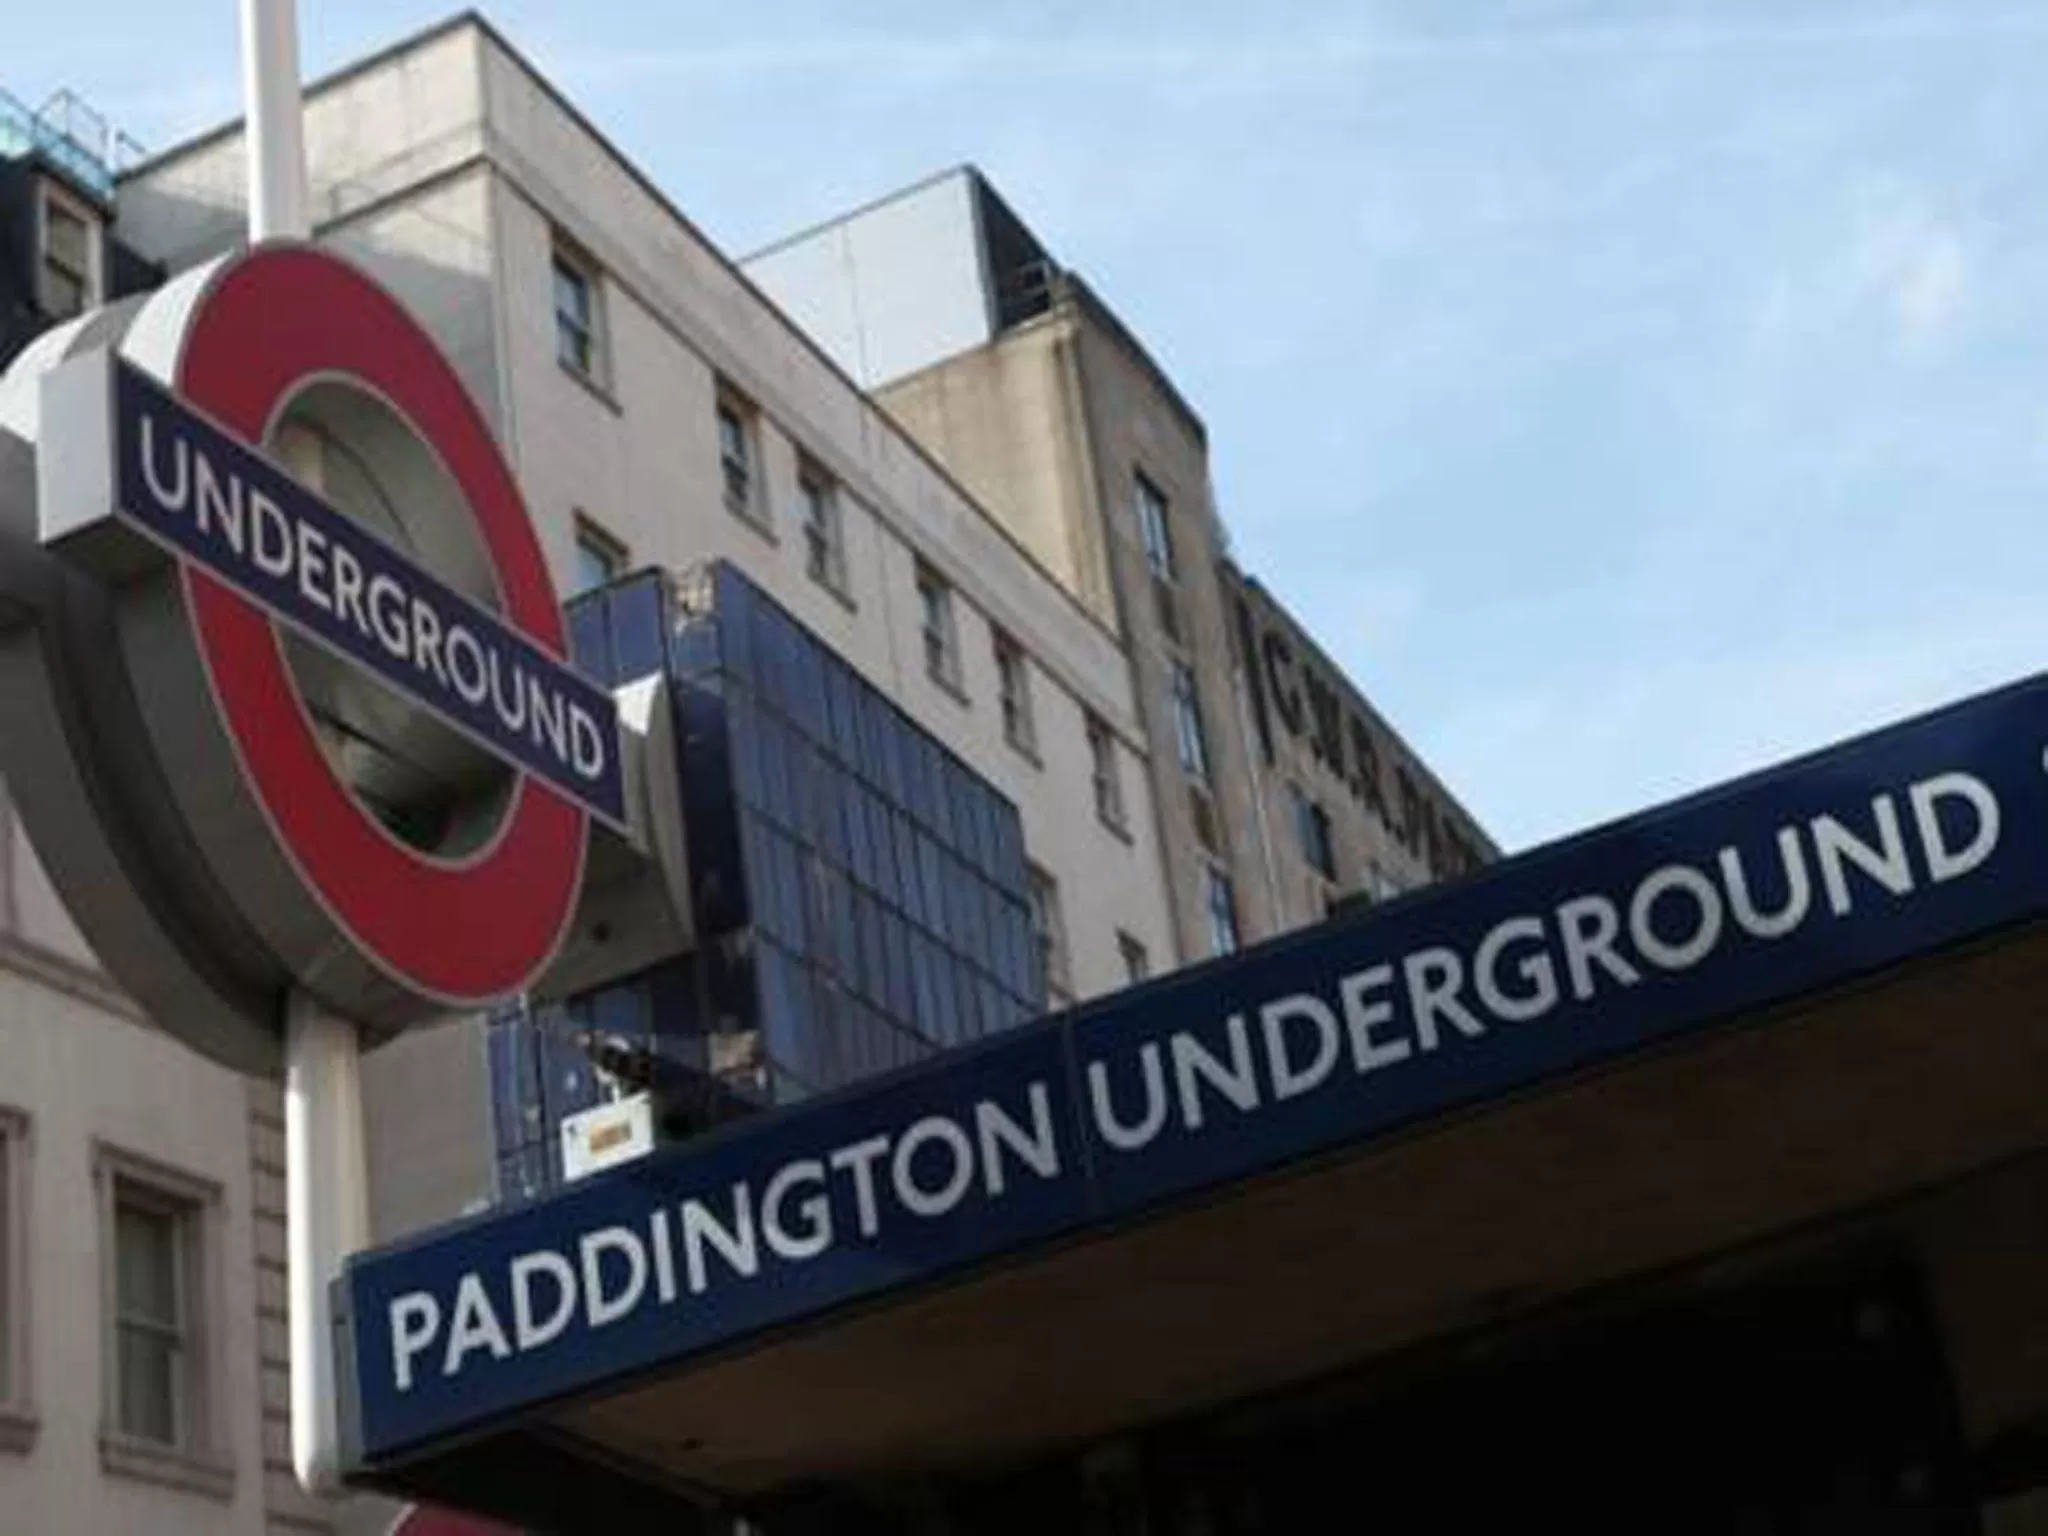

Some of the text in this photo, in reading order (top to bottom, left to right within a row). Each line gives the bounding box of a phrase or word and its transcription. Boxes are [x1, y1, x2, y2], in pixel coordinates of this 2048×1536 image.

[141, 416, 605, 780] UNDERGROUND
[388, 771, 2001, 1390] PADDINGTON UNDERGROUND
